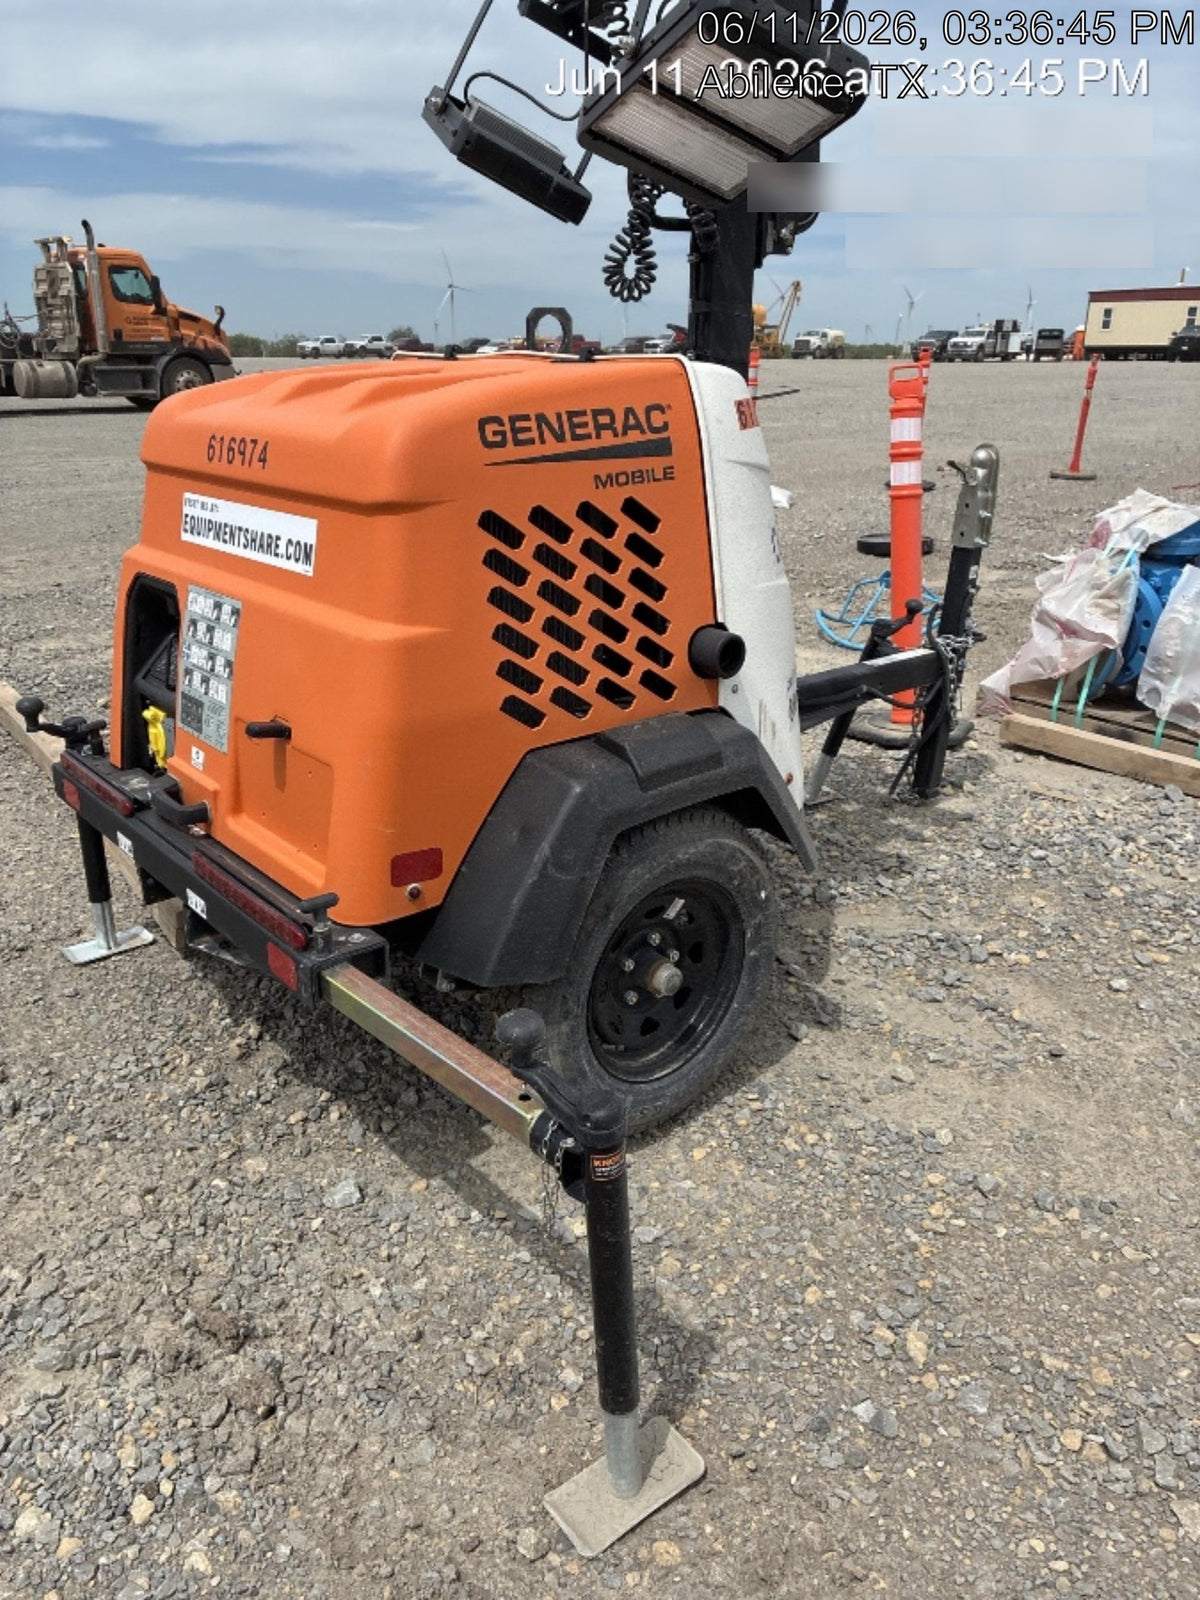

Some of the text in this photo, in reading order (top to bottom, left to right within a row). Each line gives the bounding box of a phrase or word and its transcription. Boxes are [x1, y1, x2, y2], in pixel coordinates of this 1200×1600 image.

[478, 402, 669, 449] GENERAC
[207, 434, 269, 469] 616974
[593, 465, 676, 490] MOBILE
[183, 513, 313, 567] EQUIPMENTSHARE.COM
